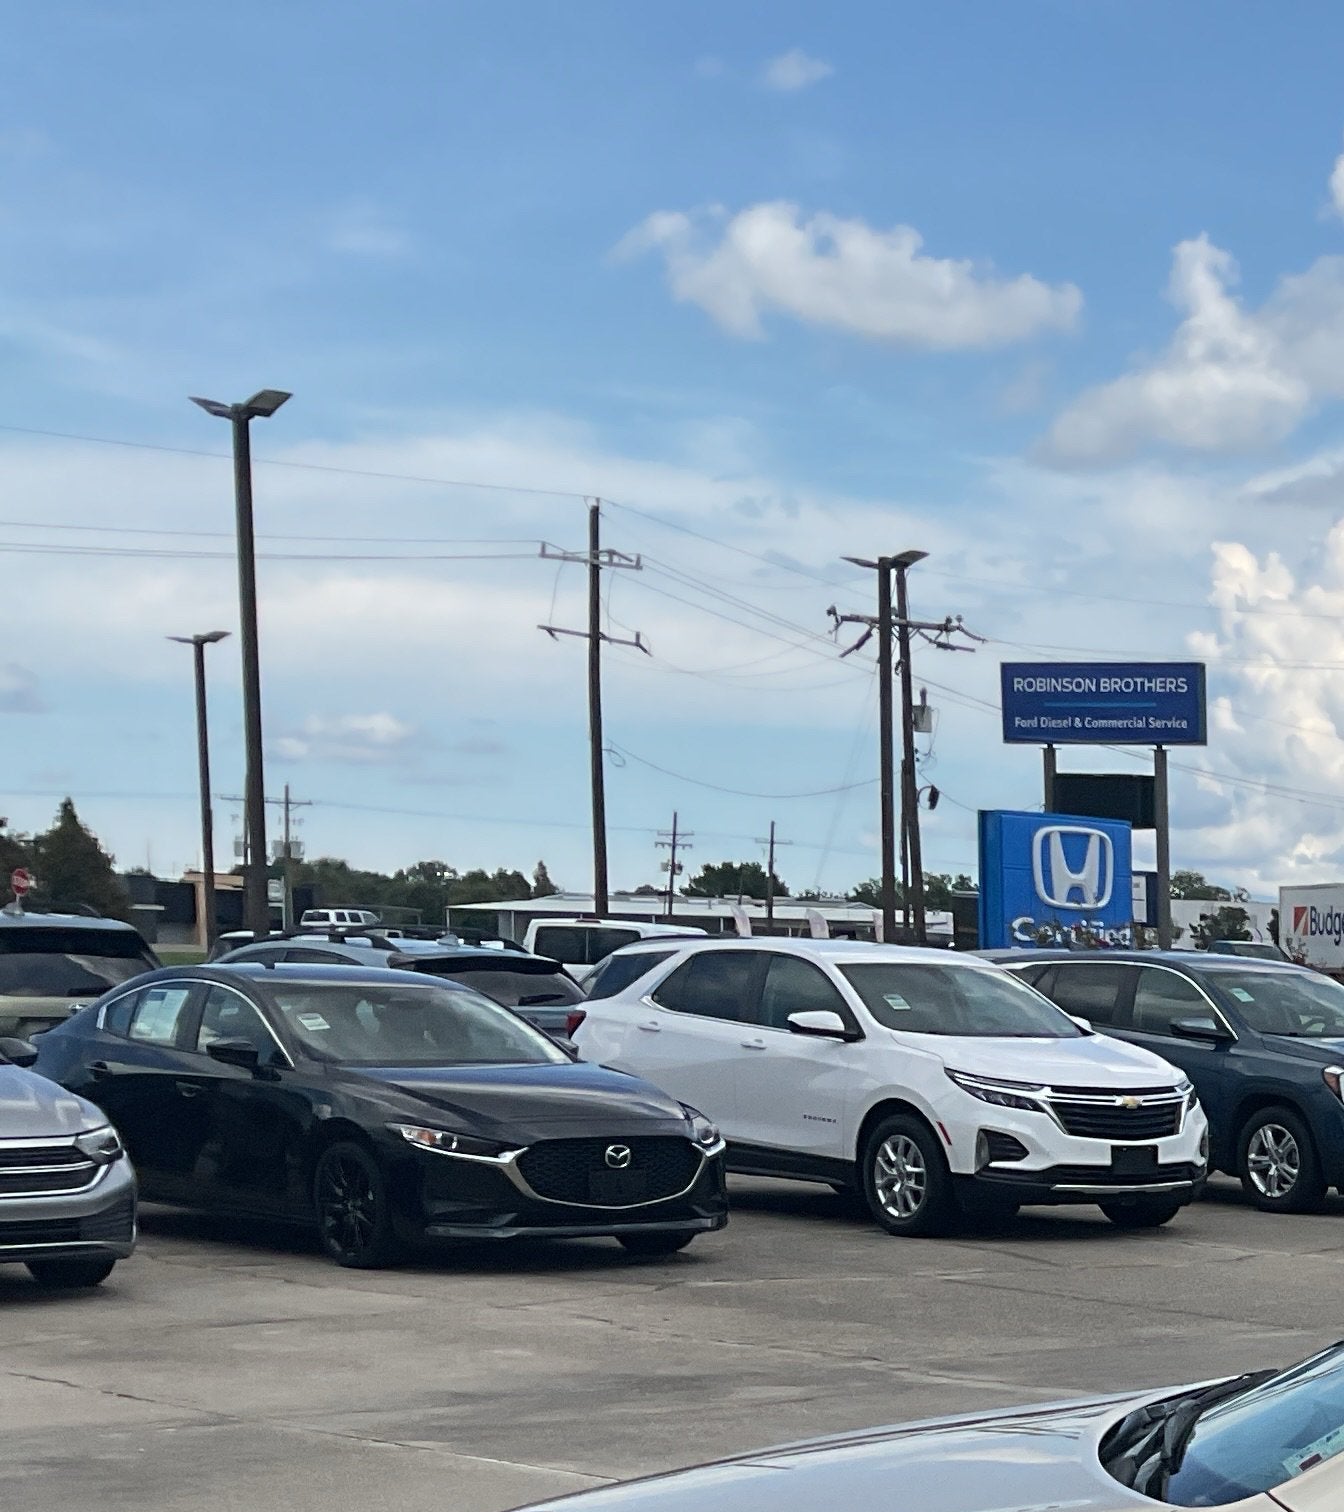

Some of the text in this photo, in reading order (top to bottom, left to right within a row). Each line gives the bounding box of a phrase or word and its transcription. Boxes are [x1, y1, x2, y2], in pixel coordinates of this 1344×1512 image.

[1013, 677, 1188, 693] ROBINSON BROTHERS
[1015, 717, 1187, 728] Ford Diesel & Commercial Service
